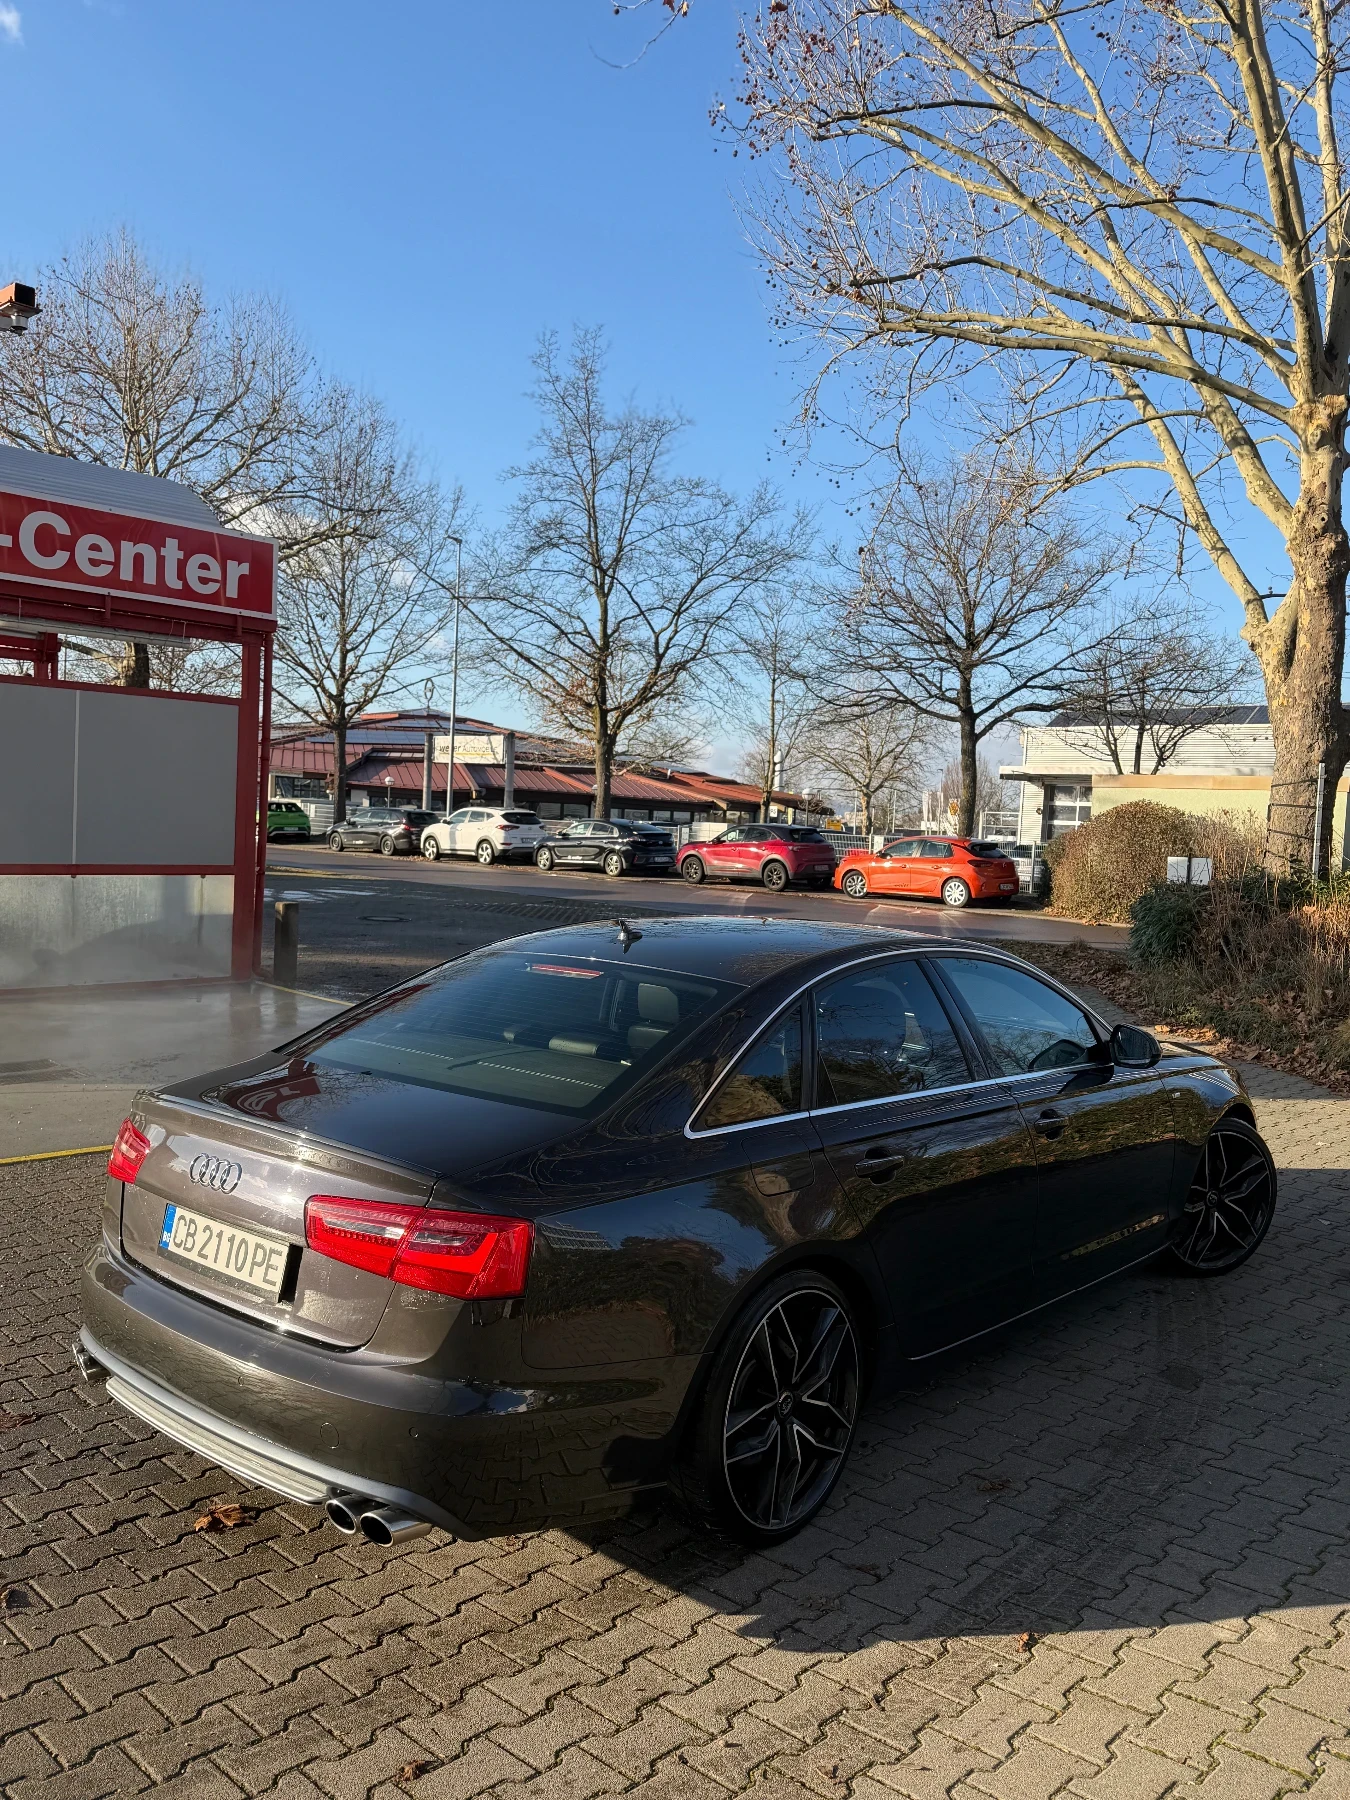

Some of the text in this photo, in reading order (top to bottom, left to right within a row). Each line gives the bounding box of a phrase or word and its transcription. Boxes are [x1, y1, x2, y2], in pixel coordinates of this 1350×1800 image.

[173, 1215, 283, 1286] CB 2110 PE
